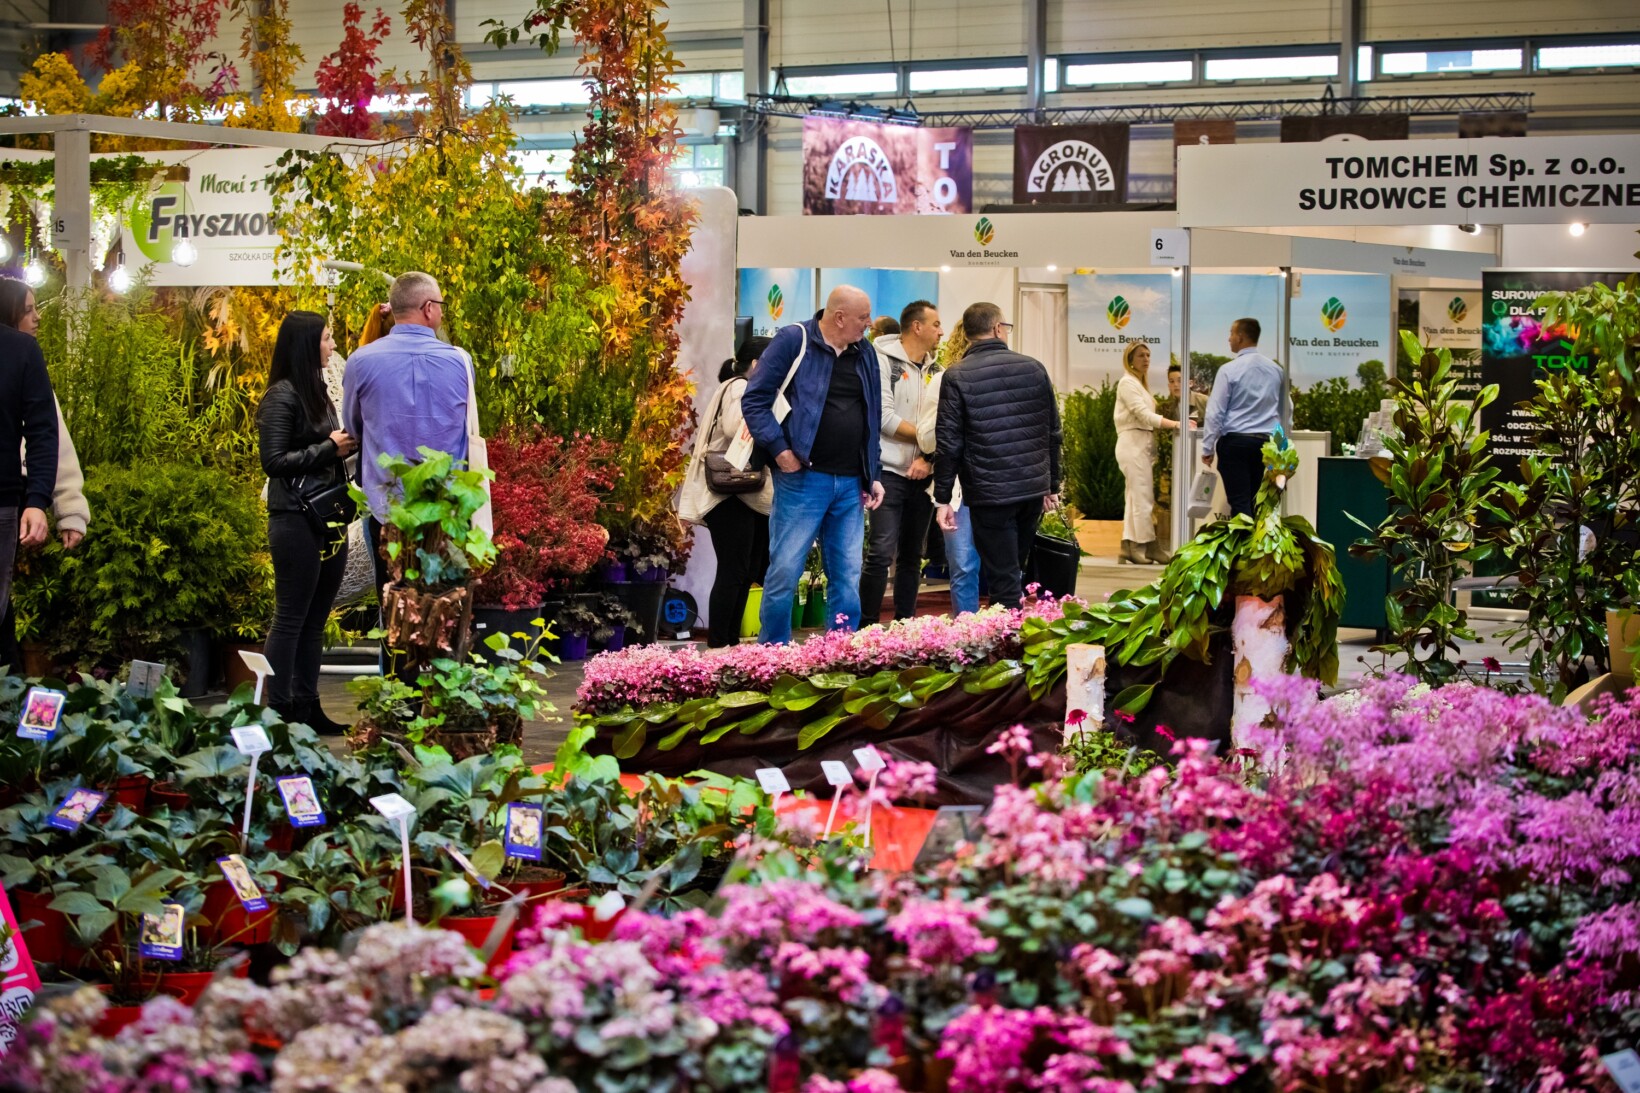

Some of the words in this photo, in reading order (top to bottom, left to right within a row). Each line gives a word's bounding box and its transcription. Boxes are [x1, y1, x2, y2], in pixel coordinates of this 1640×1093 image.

[829, 142, 893, 198] KARASKA
[1032, 143, 1111, 190] AGROHUM
[1325, 154, 1478, 179] TOMCHEM
[1488, 153, 1535, 181] Sp.
[1544, 158, 1561, 175] z
[1570, 157, 1626, 175] o.o.
[200, 173, 246, 194] Mocni
[1298, 187, 1447, 211] SUROWCE
[1456, 183, 1640, 209] CHEMICZNE
[55, 220, 65, 233] 15
[1155, 238, 1164, 250] 6
[1440, 326, 1455, 335] den
[1077, 334, 1096, 344] Van
[1098, 334, 1116, 344] den
[1289, 337, 1309, 347] Van
[1311, 337, 1331, 347] den
[1333, 337, 1379, 348] Beucken
[1531, 355, 1589, 369] TOM
